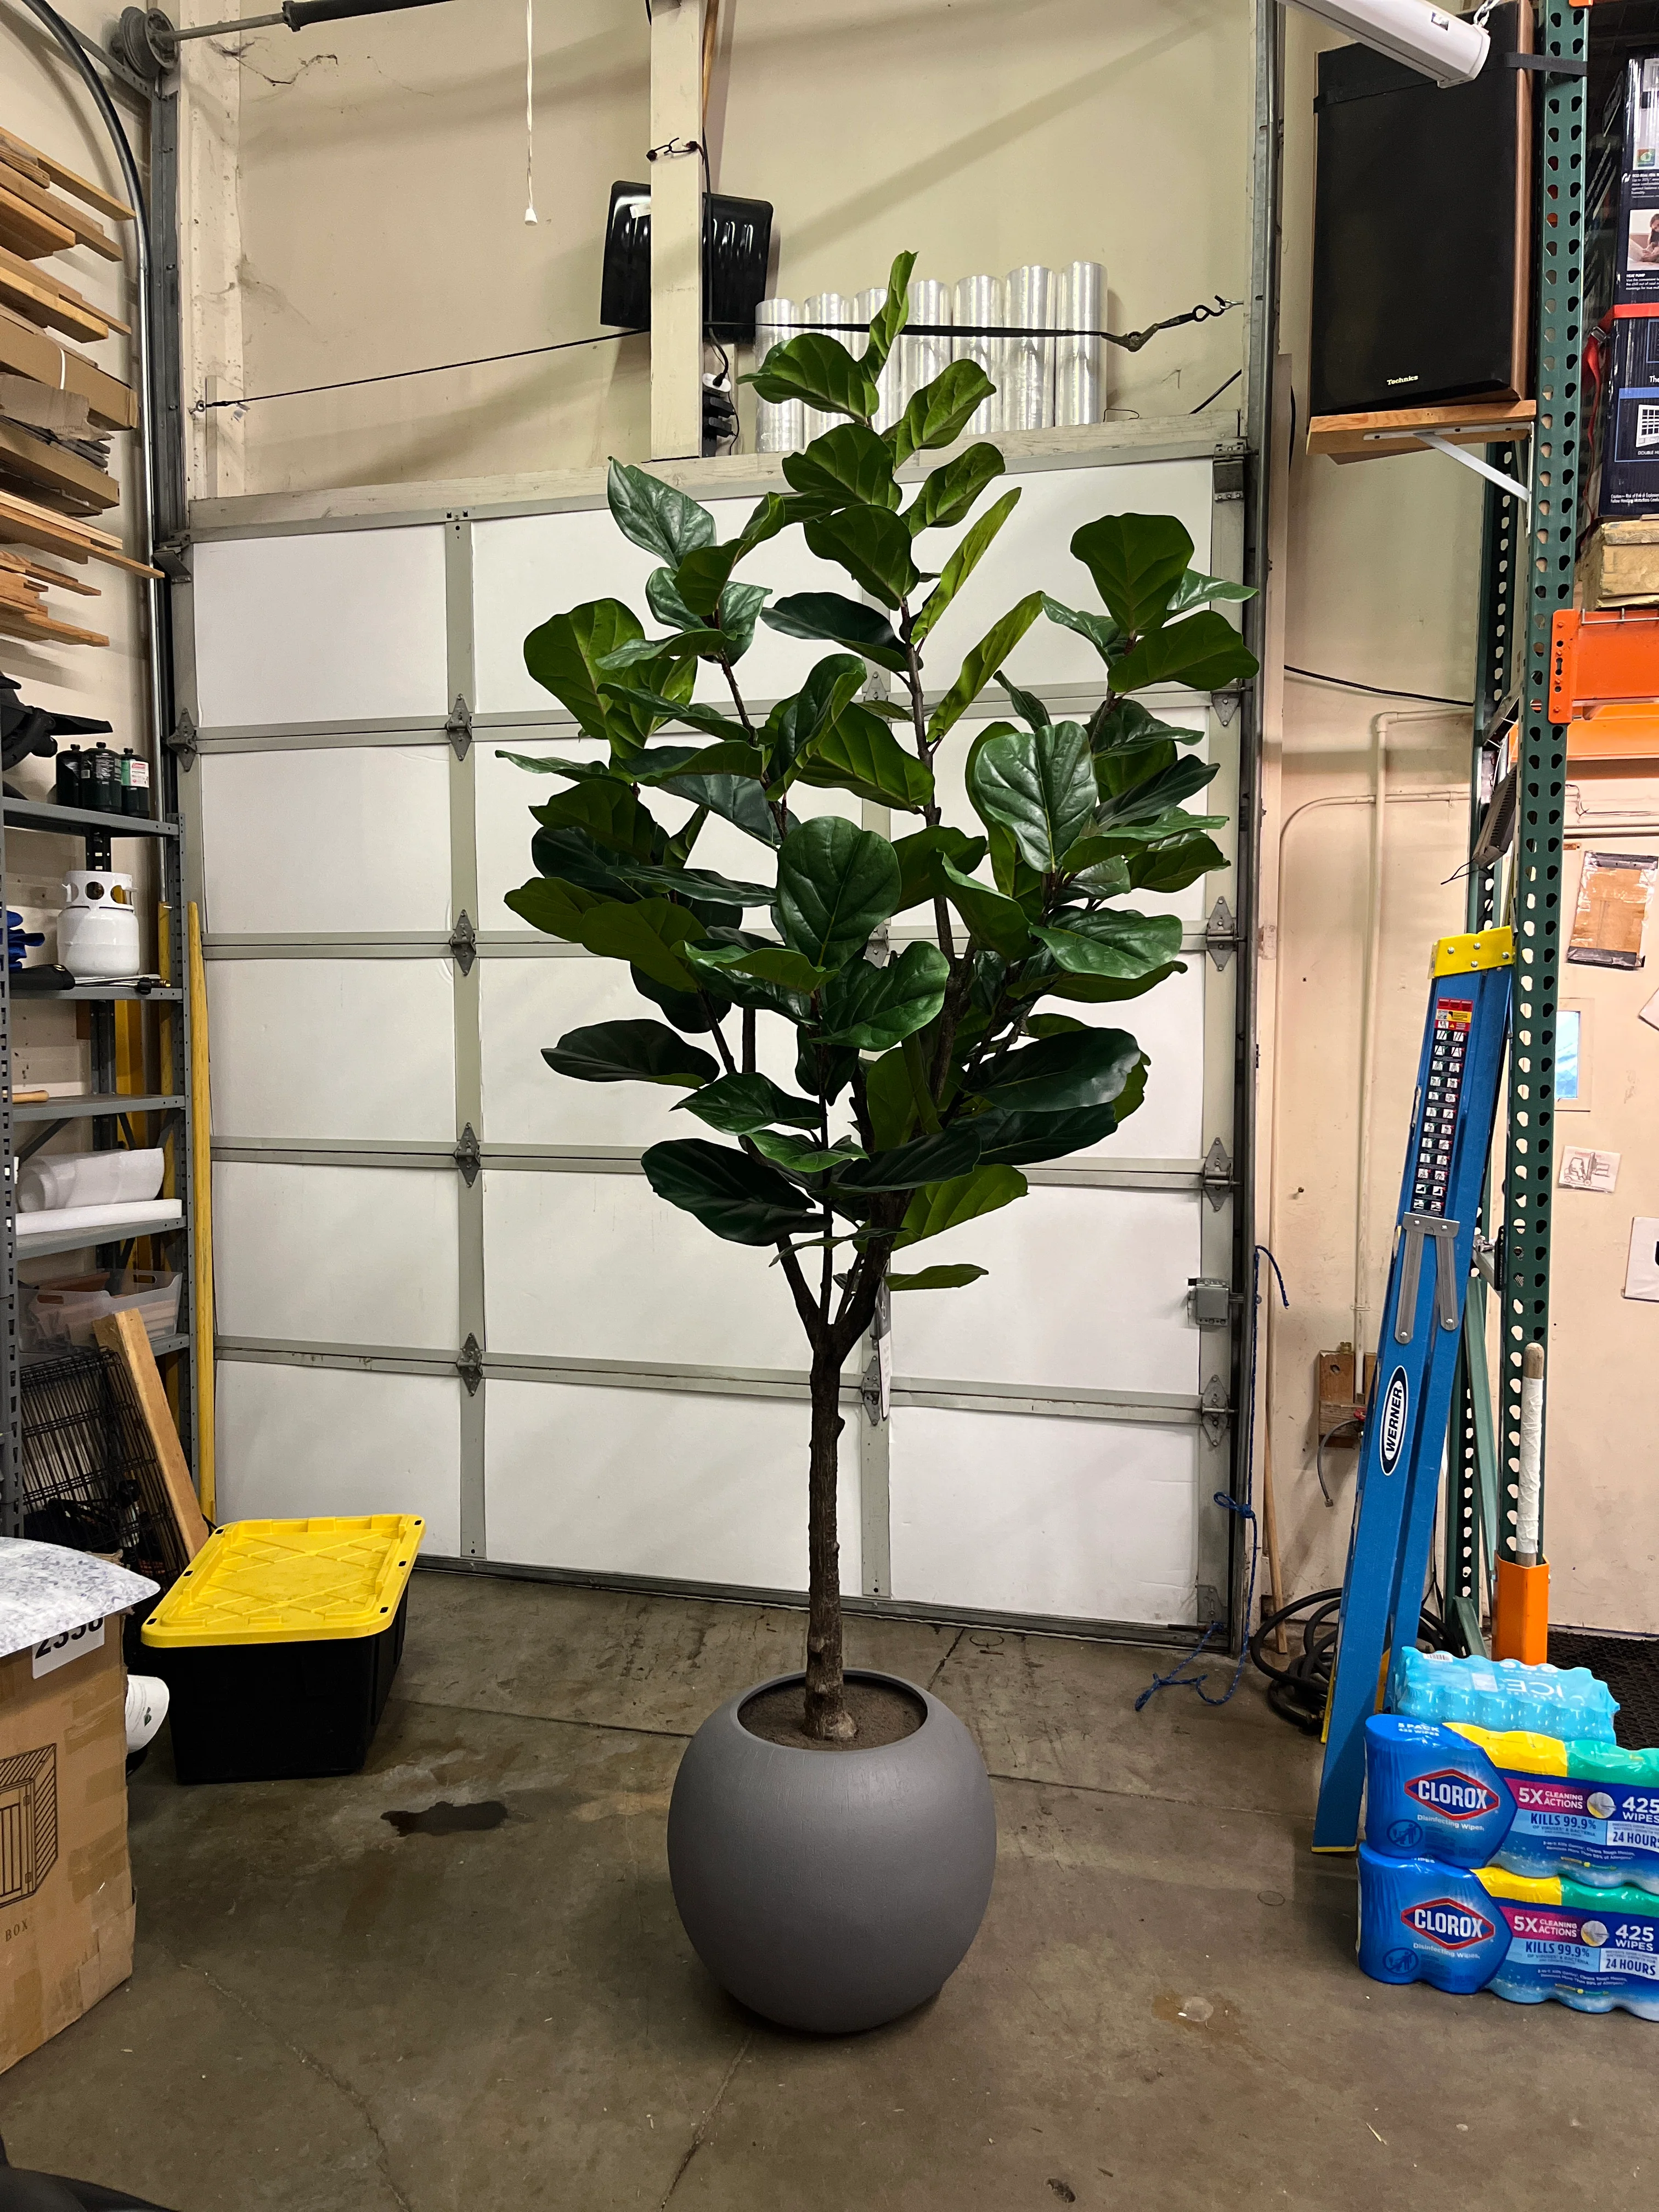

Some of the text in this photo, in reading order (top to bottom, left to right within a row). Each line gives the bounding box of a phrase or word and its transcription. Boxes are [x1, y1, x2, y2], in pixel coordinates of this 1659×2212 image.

[1386, 375, 1418, 385] Technics
[1386, 1387, 1402, 1452] WERNER
[1505, 1678, 1563, 1698] ICE
[1406, 1723, 1440, 1733] PACK
[1418, 1780, 1487, 1809] CLOROX
[1519, 1787, 1543, 1805] 5X
[1545, 1791, 1583, 1801] CLEANING
[1544, 1798, 1583, 1809] ACTIONS
[1622, 1796, 1659, 1814] 425
[1417, 1814, 1459, 1829] Disinfecting
[1531, 1813, 1596, 1830] KILLS 99.9%
[1622, 1811, 1659, 1824] WIPES
[1613, 1831, 1624, 1842] 24
[5, 1918, 28, 1942] BOX
[1414, 1909, 1482, 1938] CLOROX
[1514, 1915, 1538, 1933] 5X
[1539, 1918, 1577, 1929] CLEANING
[1538, 1926, 1577, 1938] ACTIONS
[1615, 1923, 1654, 1942] 425
[1413, 1943, 1455, 1957] Disinfecting
[1526, 1941, 1590, 1957] KILLS 99.9%
[1615, 1939, 1654, 1951] WIPES
[1606, 1959, 1656, 1976] 24 HOURS
